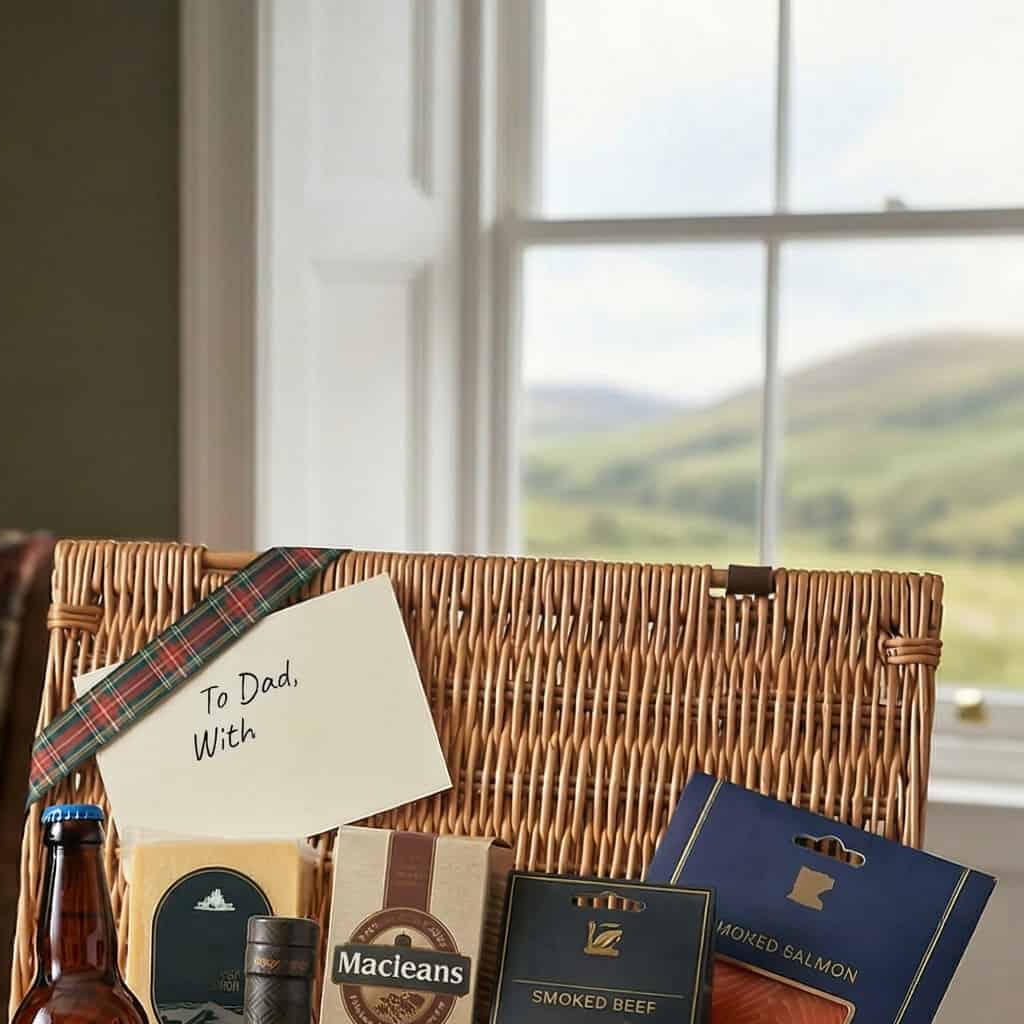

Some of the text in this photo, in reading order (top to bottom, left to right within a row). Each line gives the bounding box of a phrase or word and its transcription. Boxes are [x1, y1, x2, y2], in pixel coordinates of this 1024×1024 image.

[200, 660, 299, 714] To Dad,
[194, 718, 256, 761] With
[338, 951, 464, 984] Macleans
[716, 920, 858, 984] MOKED SALMON
[532, 990, 657, 1014] SMOKED BEEF
